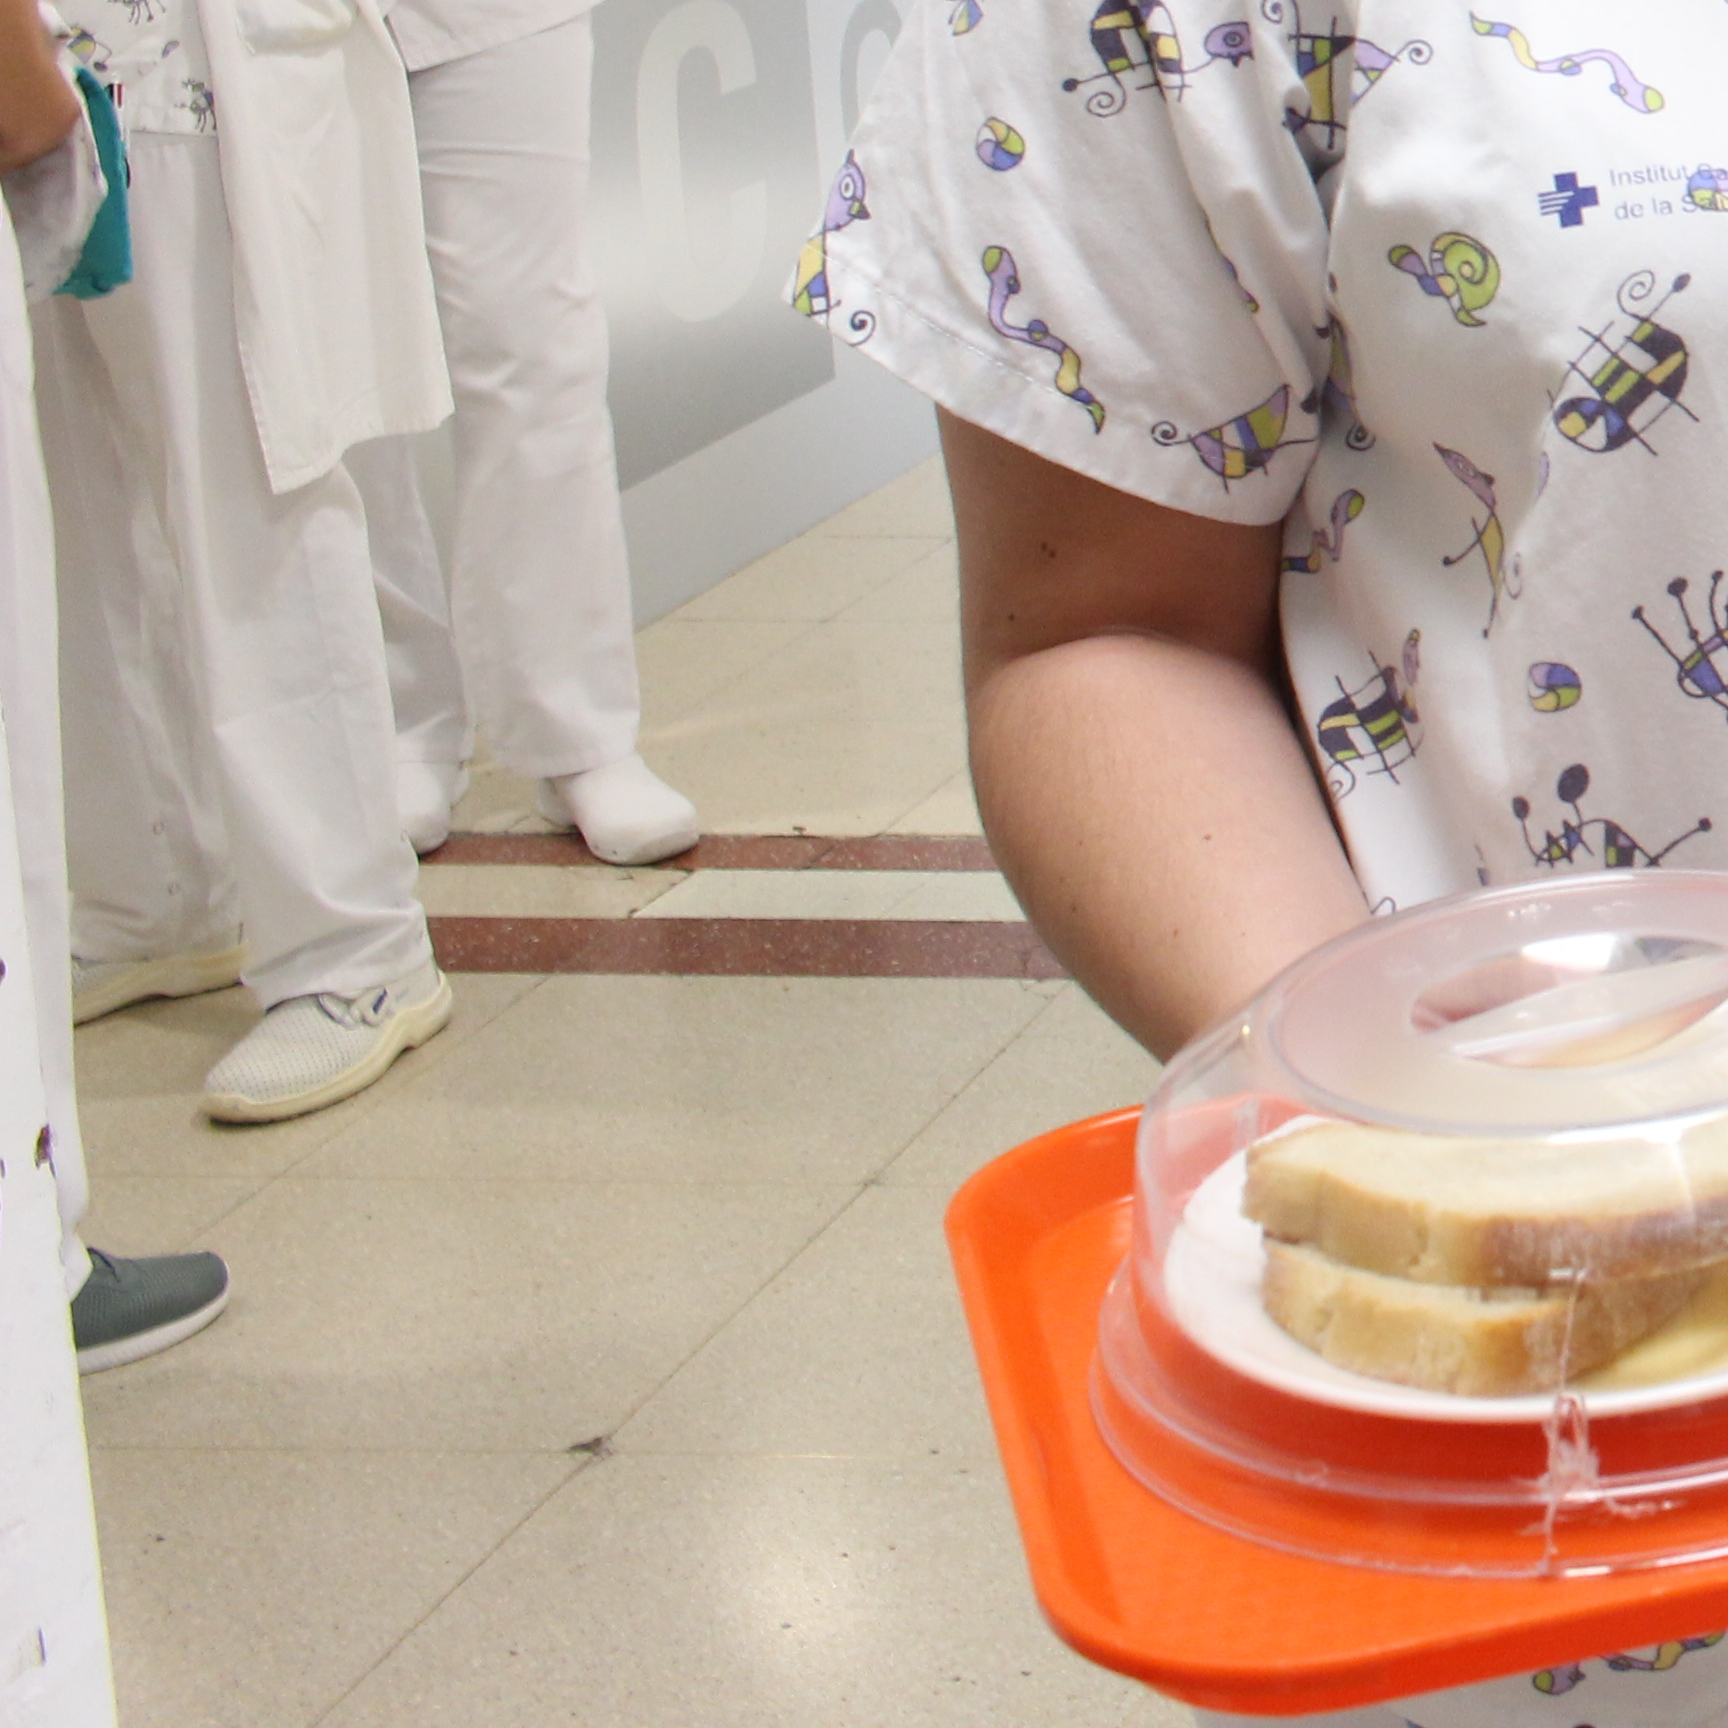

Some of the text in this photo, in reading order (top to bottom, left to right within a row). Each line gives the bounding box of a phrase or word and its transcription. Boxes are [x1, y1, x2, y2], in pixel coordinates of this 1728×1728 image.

[1608, 164, 1692, 187] Institut
[1614, 200, 1645, 221] de
[1652, 197, 1674, 216] la
